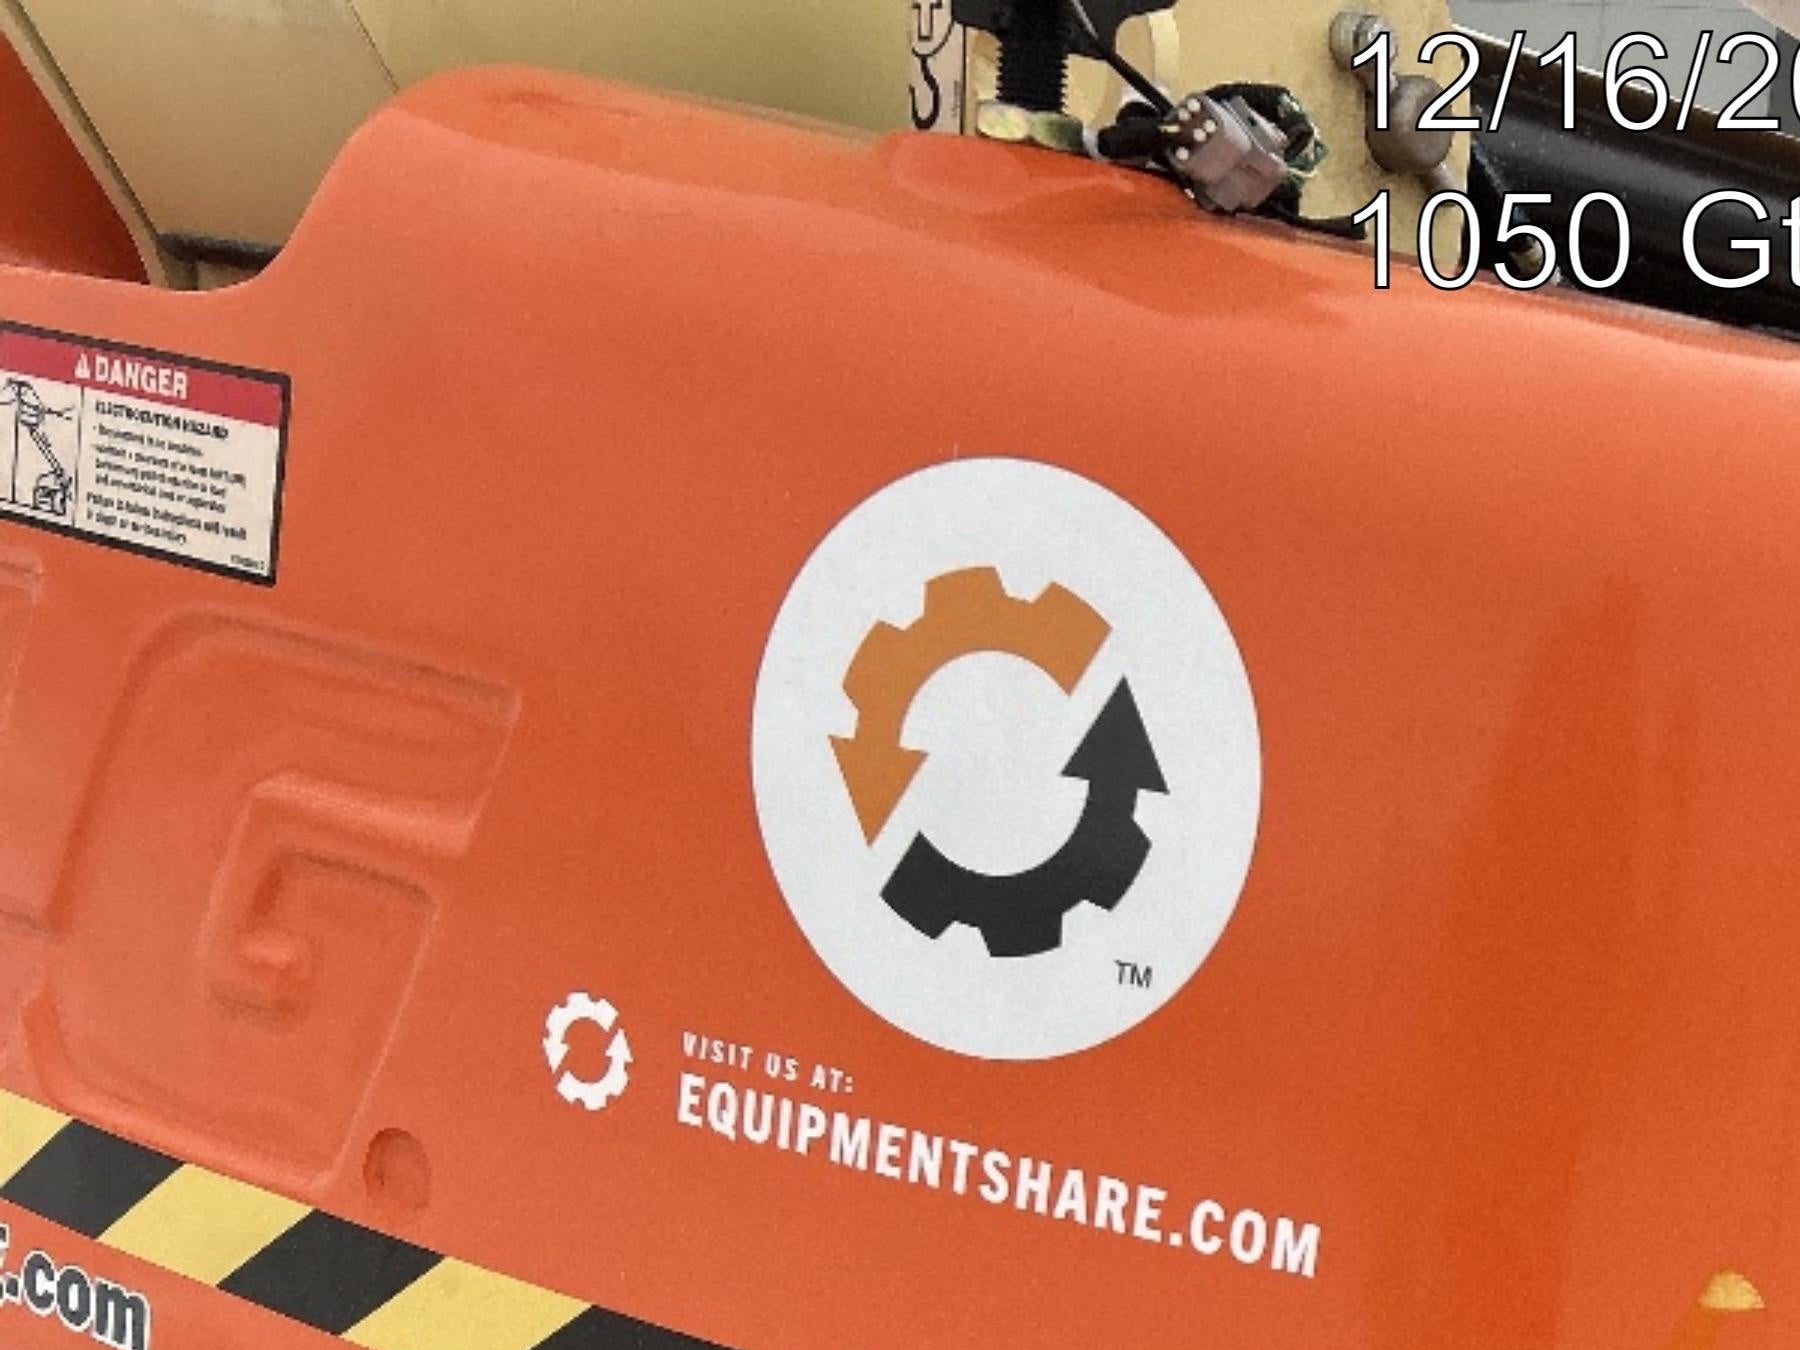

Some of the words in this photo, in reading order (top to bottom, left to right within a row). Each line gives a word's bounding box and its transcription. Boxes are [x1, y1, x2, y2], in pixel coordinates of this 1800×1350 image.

[95, 354, 188, 400] DANGER
[1113, 959, 1153, 988] TM
[682, 1030, 754, 1073] VISIT
[765, 1052, 800, 1082] US
[809, 1063, 854, 1094] AT:
[676, 1071, 1323, 1279] EQUIPMENTSHARE.COM
